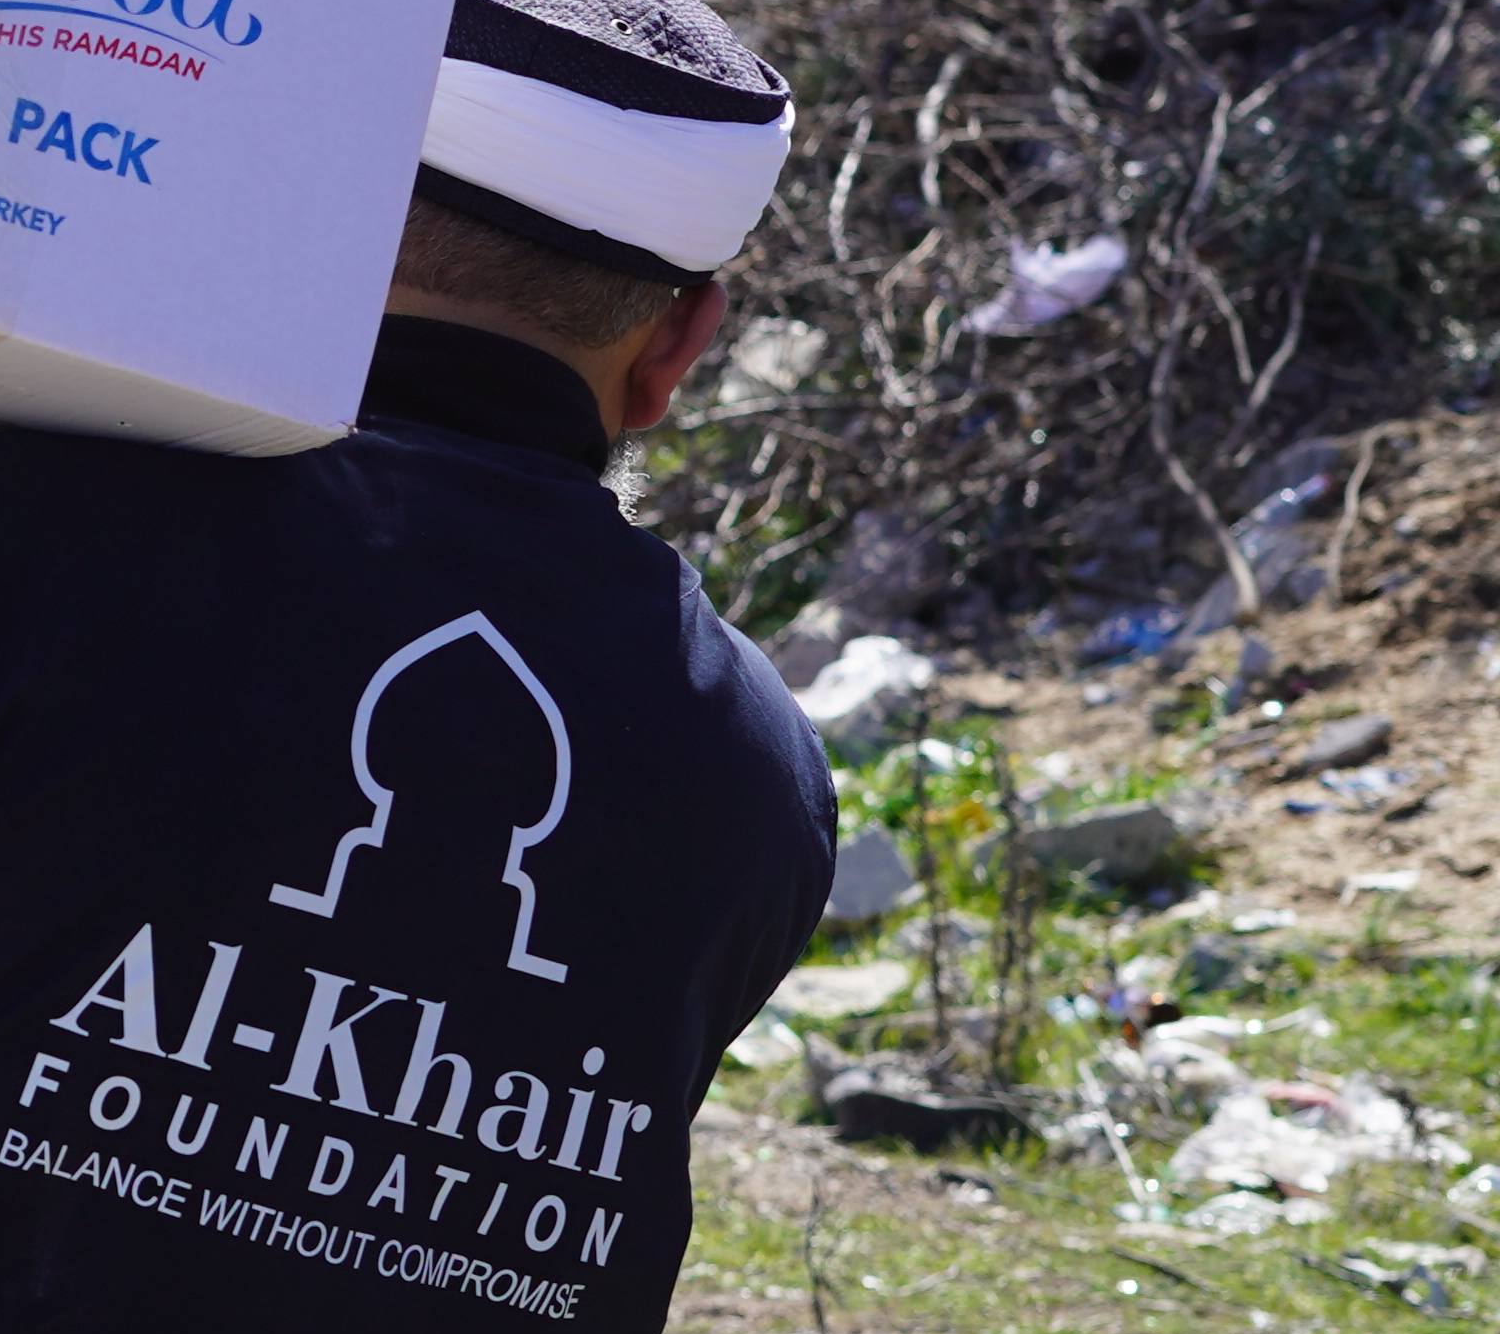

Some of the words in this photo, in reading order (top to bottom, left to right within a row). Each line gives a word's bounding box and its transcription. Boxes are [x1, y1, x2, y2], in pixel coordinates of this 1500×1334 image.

[53, 29, 206, 81] RAMADAN
[8, 97, 159, 185] PACK
[49, 922, 653, 1182] Al-Khair
[19, 1052, 624, 1268] FOUNDATION
[199, 1189, 376, 1270] WITHOUT
[377, 1239, 585, 1321] COMPROMISE
